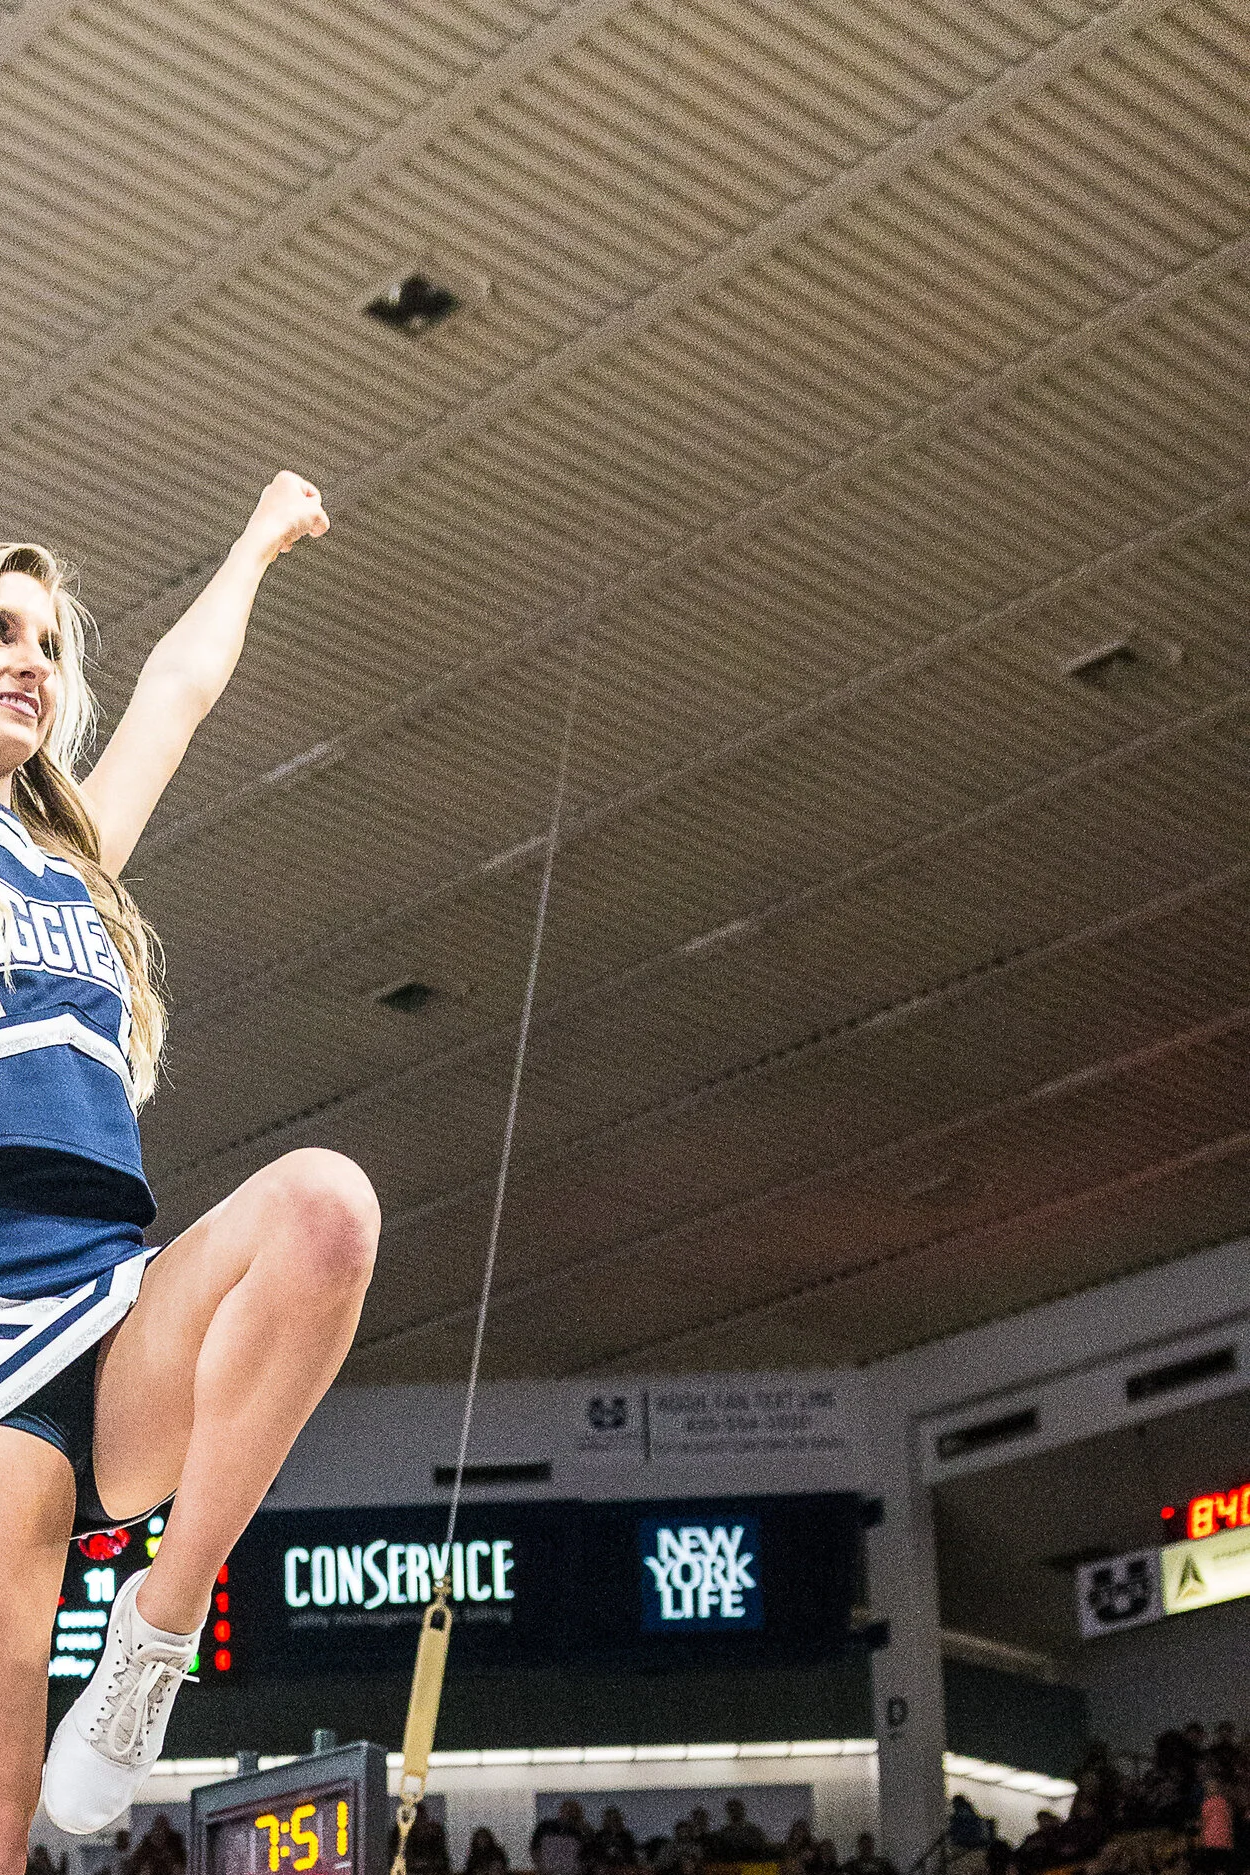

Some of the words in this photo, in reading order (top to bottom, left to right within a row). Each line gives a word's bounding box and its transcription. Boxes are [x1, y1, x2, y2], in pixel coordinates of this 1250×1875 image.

[656, 1525, 745, 1560] NEW
[284, 1540, 514, 1610] CONSERVICE
[643, 1552, 757, 1592] YORK
[660, 1586, 746, 1620] LIFE
[254, 1800, 348, 1871] 7:51
